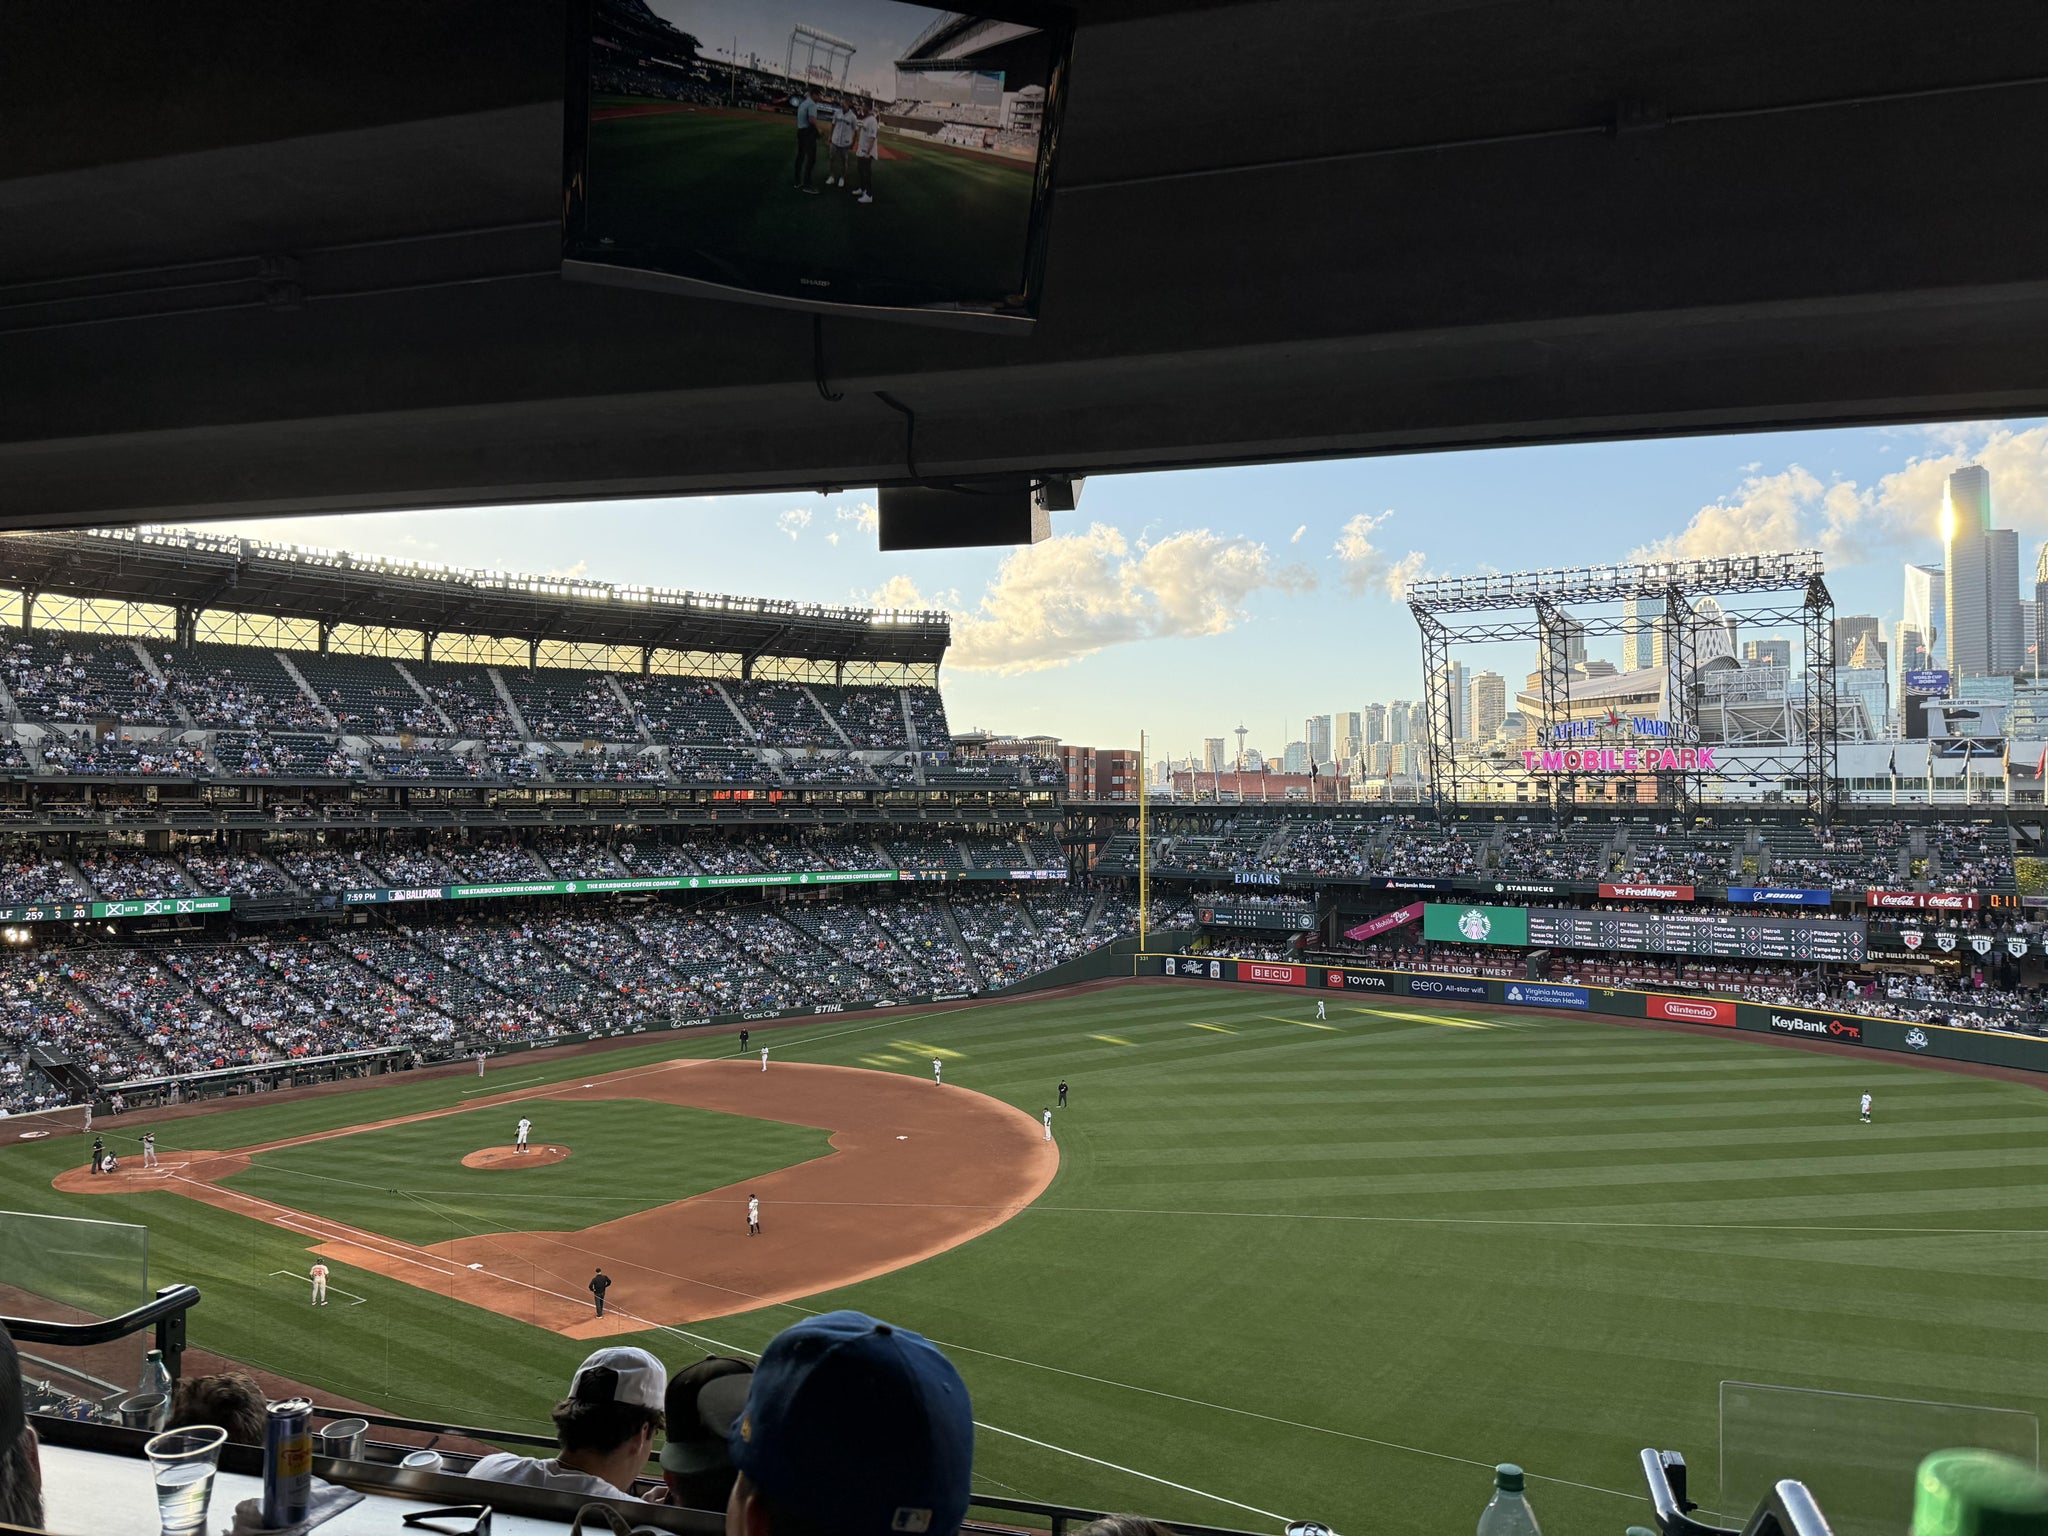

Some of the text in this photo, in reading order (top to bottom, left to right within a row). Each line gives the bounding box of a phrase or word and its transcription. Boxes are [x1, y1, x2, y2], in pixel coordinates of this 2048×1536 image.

[1537, 717, 1700, 743] SEATTLE MARINERS
[1522, 747, 1716, 771] T-MOBILE PARK
[1235, 874, 1280, 885] EDGARS
[406, 889, 442, 899] BALLPARK
[1625, 887, 1647, 897] Fred
[1764, 892, 1803, 900] BOEING
[1990, 894, 2017, 907] 0:11
[23, 912, 43, 920] .259
[74, 910, 85, 918] 20
[1375, 918, 1393, 929] Mobile
[1391, 911, 1410, 923] Pen
[1906, 937, 1919, 945] 42
[1967, 934, 1994, 942] MARTINEZ
[1940, 939, 1952, 948] 24
[1976, 942, 1985, 950] 11
[2012, 944, 2022, 953] 51
[1418, 963, 1428, 971] IN
[1430, 964, 1449, 972] THE
[1254, 969, 1289, 979] BECU
[1347, 976, 1386, 987] TOYOTA
[1412, 981, 1443, 992] eero
[1590, 975, 1610, 983] THE
[1703, 982, 1715, 990] IN
[1718, 983, 1740, 992] THE
[1525, 988, 1550, 996] Virginia
[1525, 995, 1562, 1003] Franciscan
[814, 1004, 843, 1014] STIHL
[1669, 1004, 1714, 1016] Nintendo
[682, 1018, 710, 1026] LEXUS
[1772, 1015, 1828, 1034] KeyBank
[1910, 1032, 1924, 1042] 50
